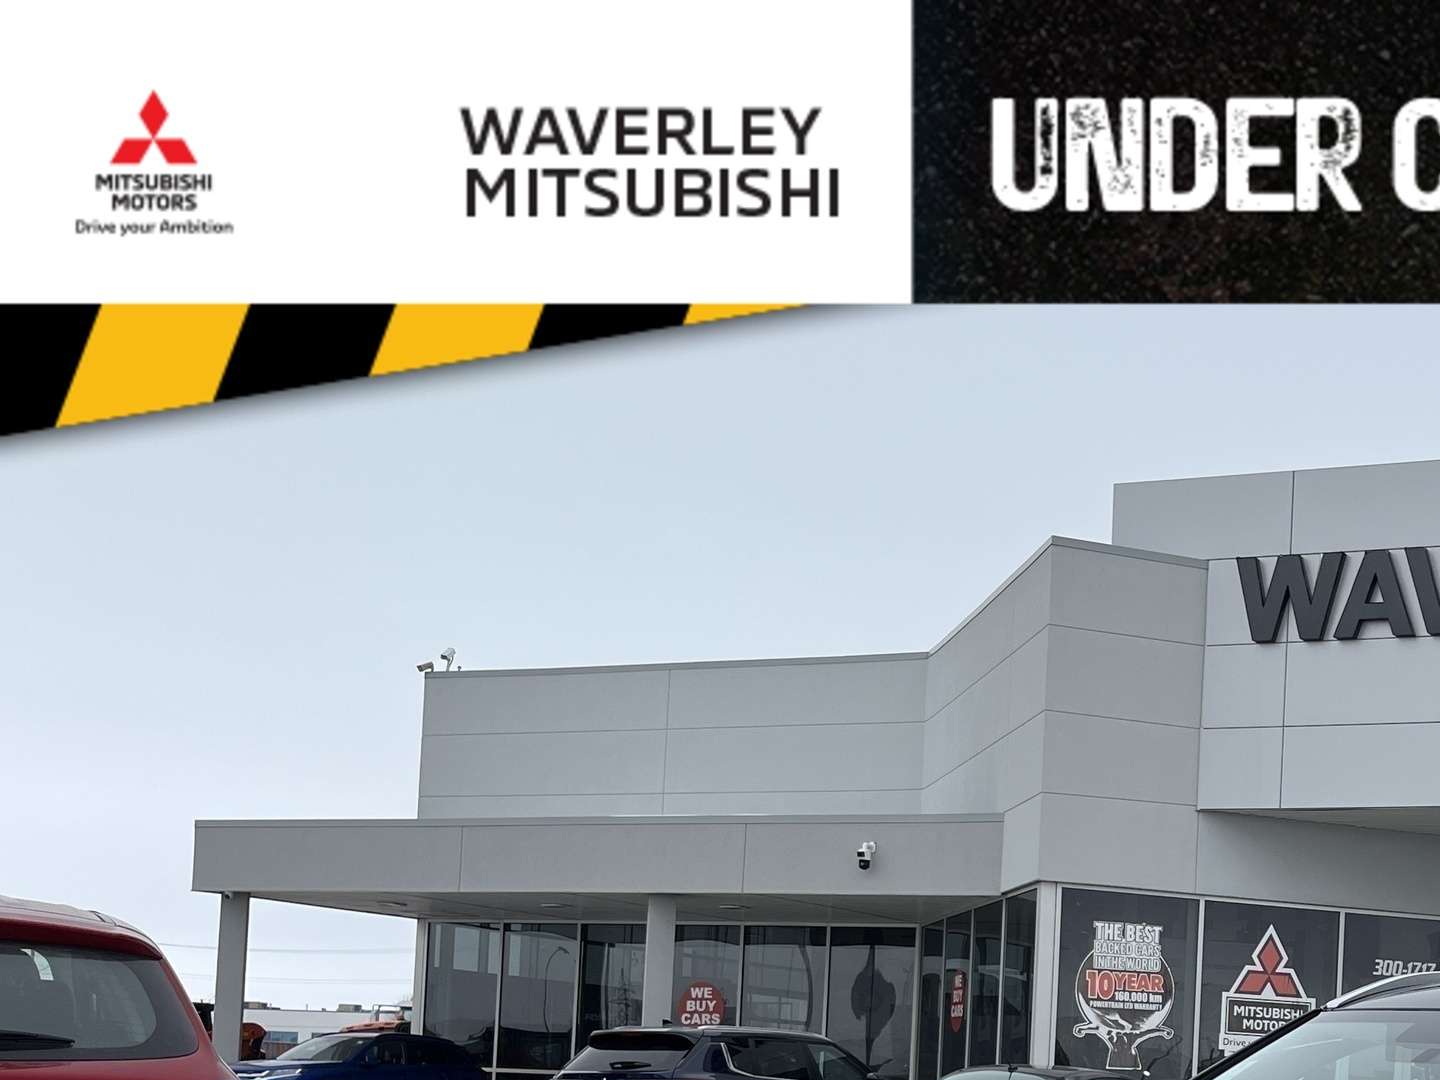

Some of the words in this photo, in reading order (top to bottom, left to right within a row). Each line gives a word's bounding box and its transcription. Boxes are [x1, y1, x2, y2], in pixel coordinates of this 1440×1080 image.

[1094, 921, 1123, 941] THE
[1126, 924, 1162, 944] BEST
[1095, 941, 1133, 955] BACKED
[1135, 943, 1161, 957] CARS
[1126, 957, 1161, 971] WORLD
[1086, 970, 1115, 1000] 10
[1112, 972, 1164, 993] YEAR
[691, 987, 713, 998] WE
[686, 1000, 717, 1012] BUY
[681, 1013, 721, 1025] CARS
[1223, 1037, 1246, 1047] Drive
